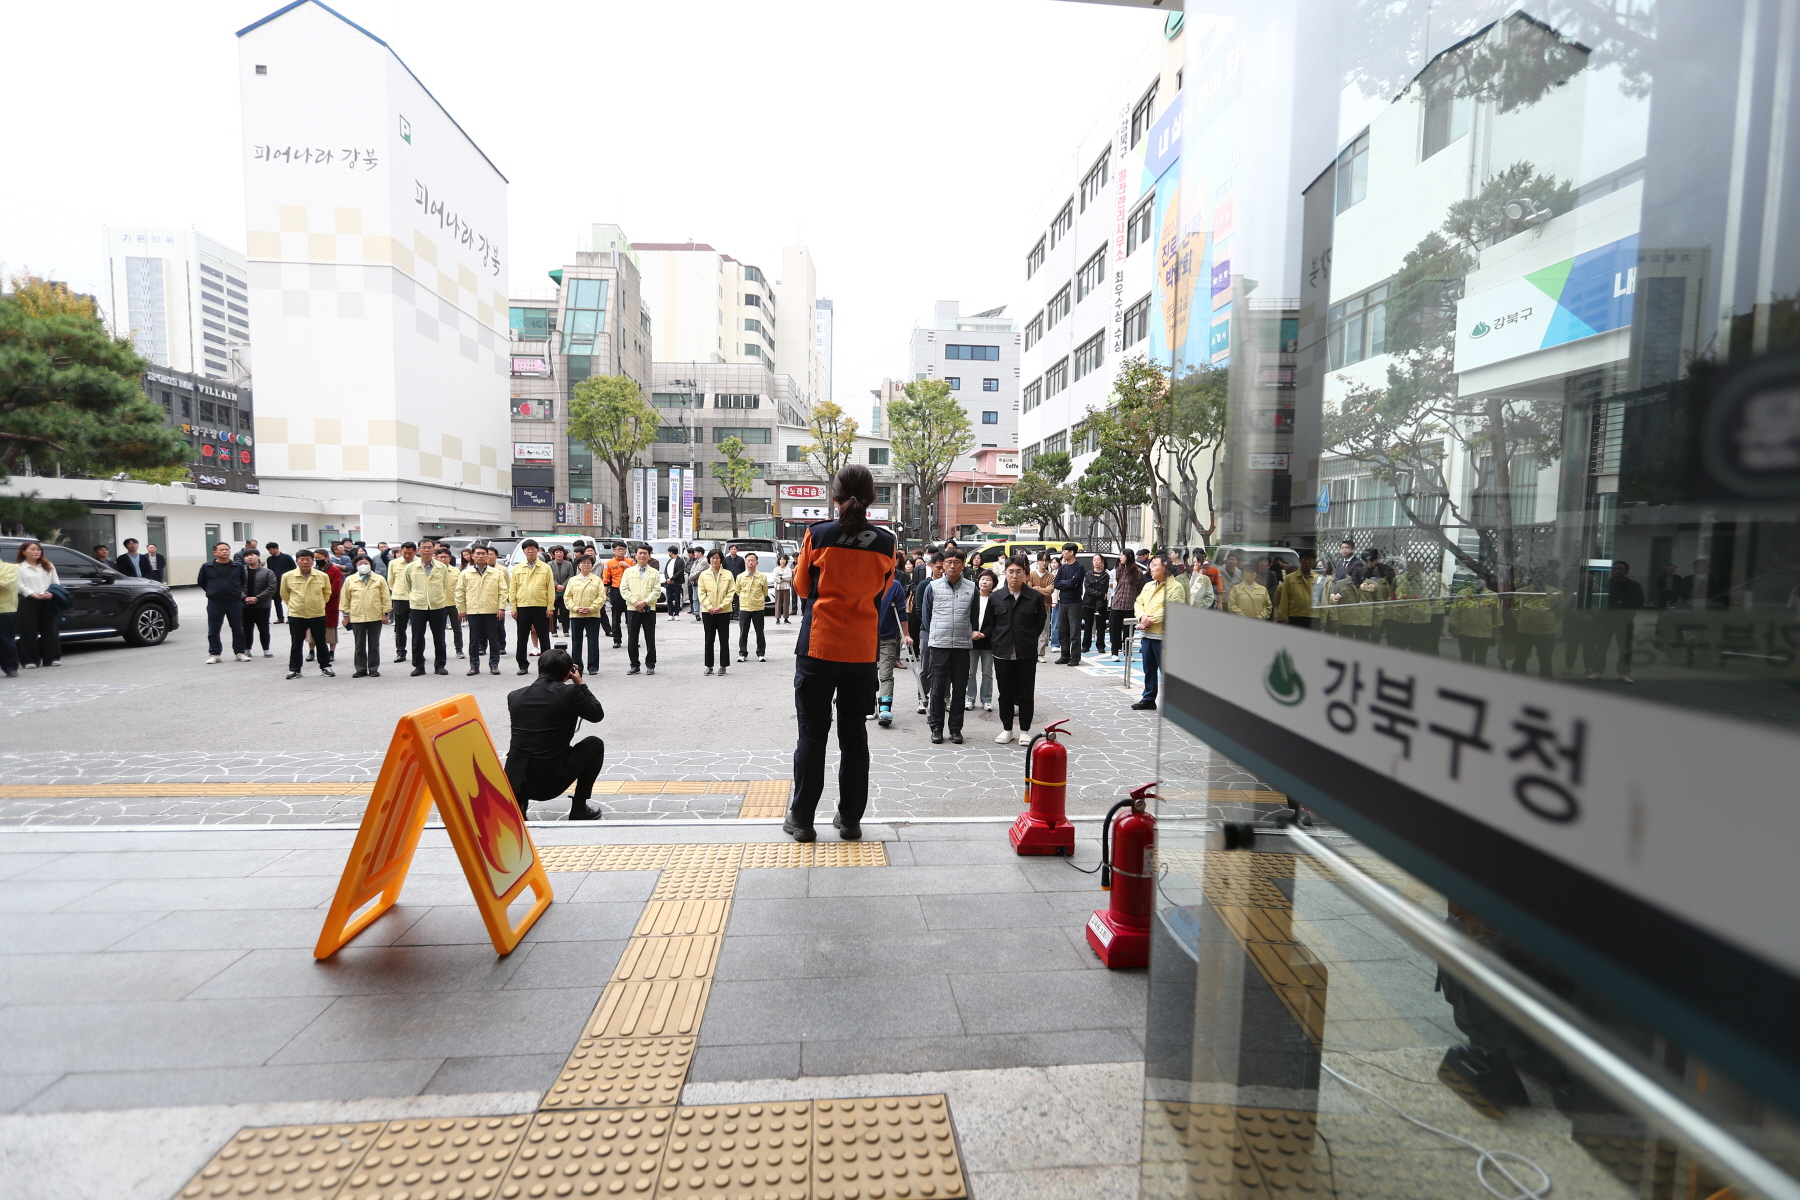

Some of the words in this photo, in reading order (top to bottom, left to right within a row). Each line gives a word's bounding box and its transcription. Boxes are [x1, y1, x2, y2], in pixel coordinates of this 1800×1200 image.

[1119, 117, 1129, 160] 강북구
[1158, 126, 1170, 159] 내
[254, 144, 334, 164] 피어나라
[341, 147, 379, 172] 강북
[414, 178, 474, 250] 피어나라
[478, 233, 501, 277] 강북
[1115, 270, 1123, 323] 최우수상
[1493, 307, 1533, 330] 강북구
[1114, 327, 1122, 353] 수상
[197, 383, 238, 401] VILLAIN
[836, 530, 878, 548] 119
[1323, 657, 1588, 826] 강북구청
